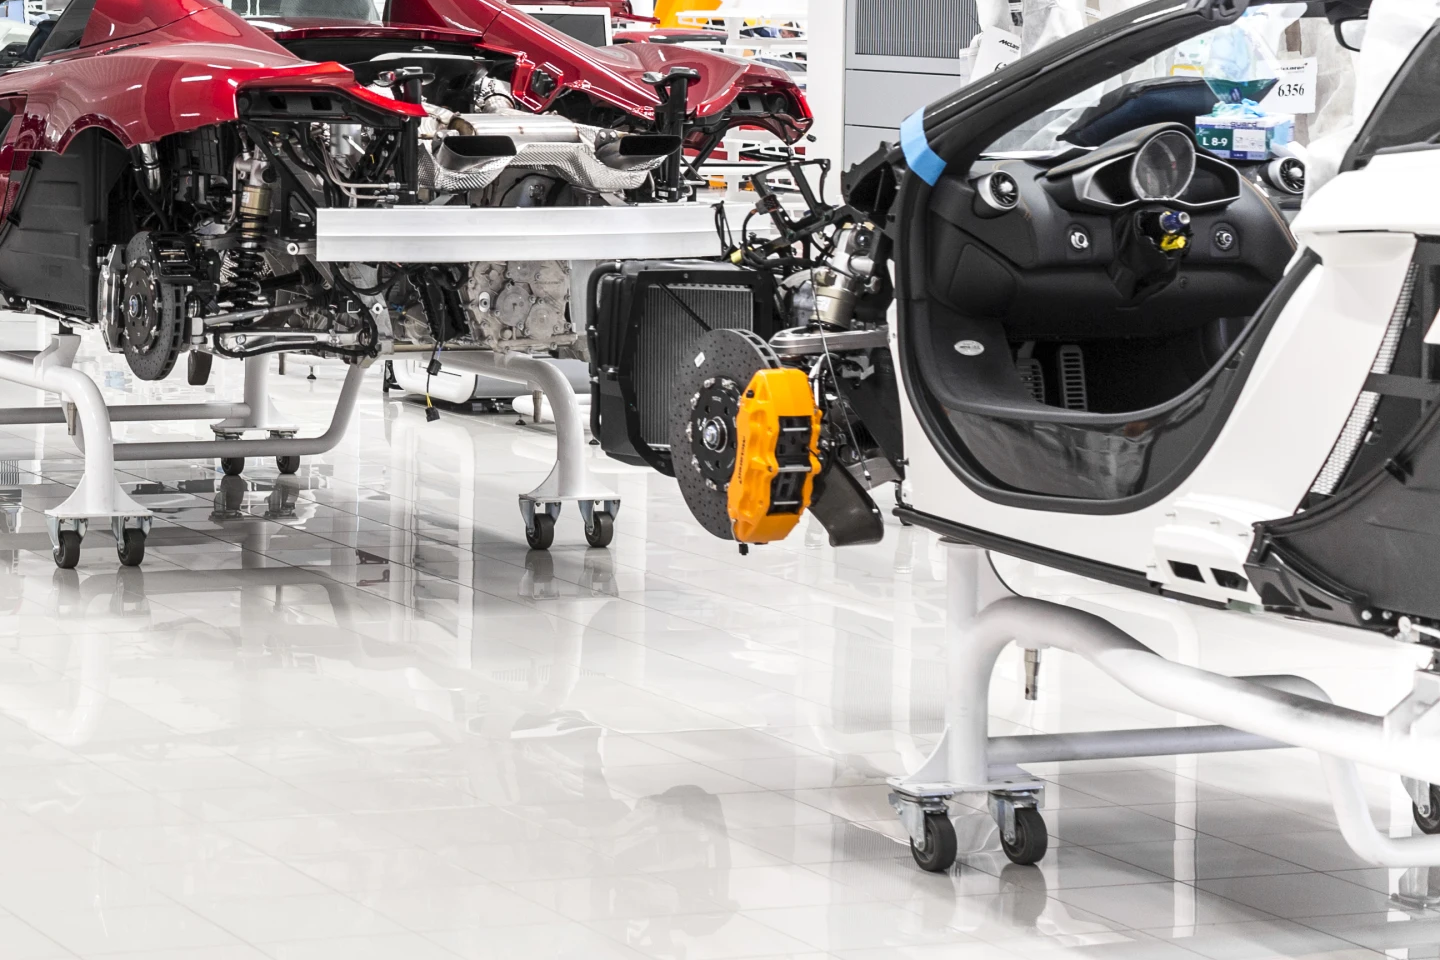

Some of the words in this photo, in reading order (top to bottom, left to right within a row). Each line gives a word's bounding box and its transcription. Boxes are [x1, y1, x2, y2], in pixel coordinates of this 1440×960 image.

[1277, 83, 1305, 98] 6356
[1202, 137, 1209, 146] L
[1211, 137, 1228, 147] 8-9
